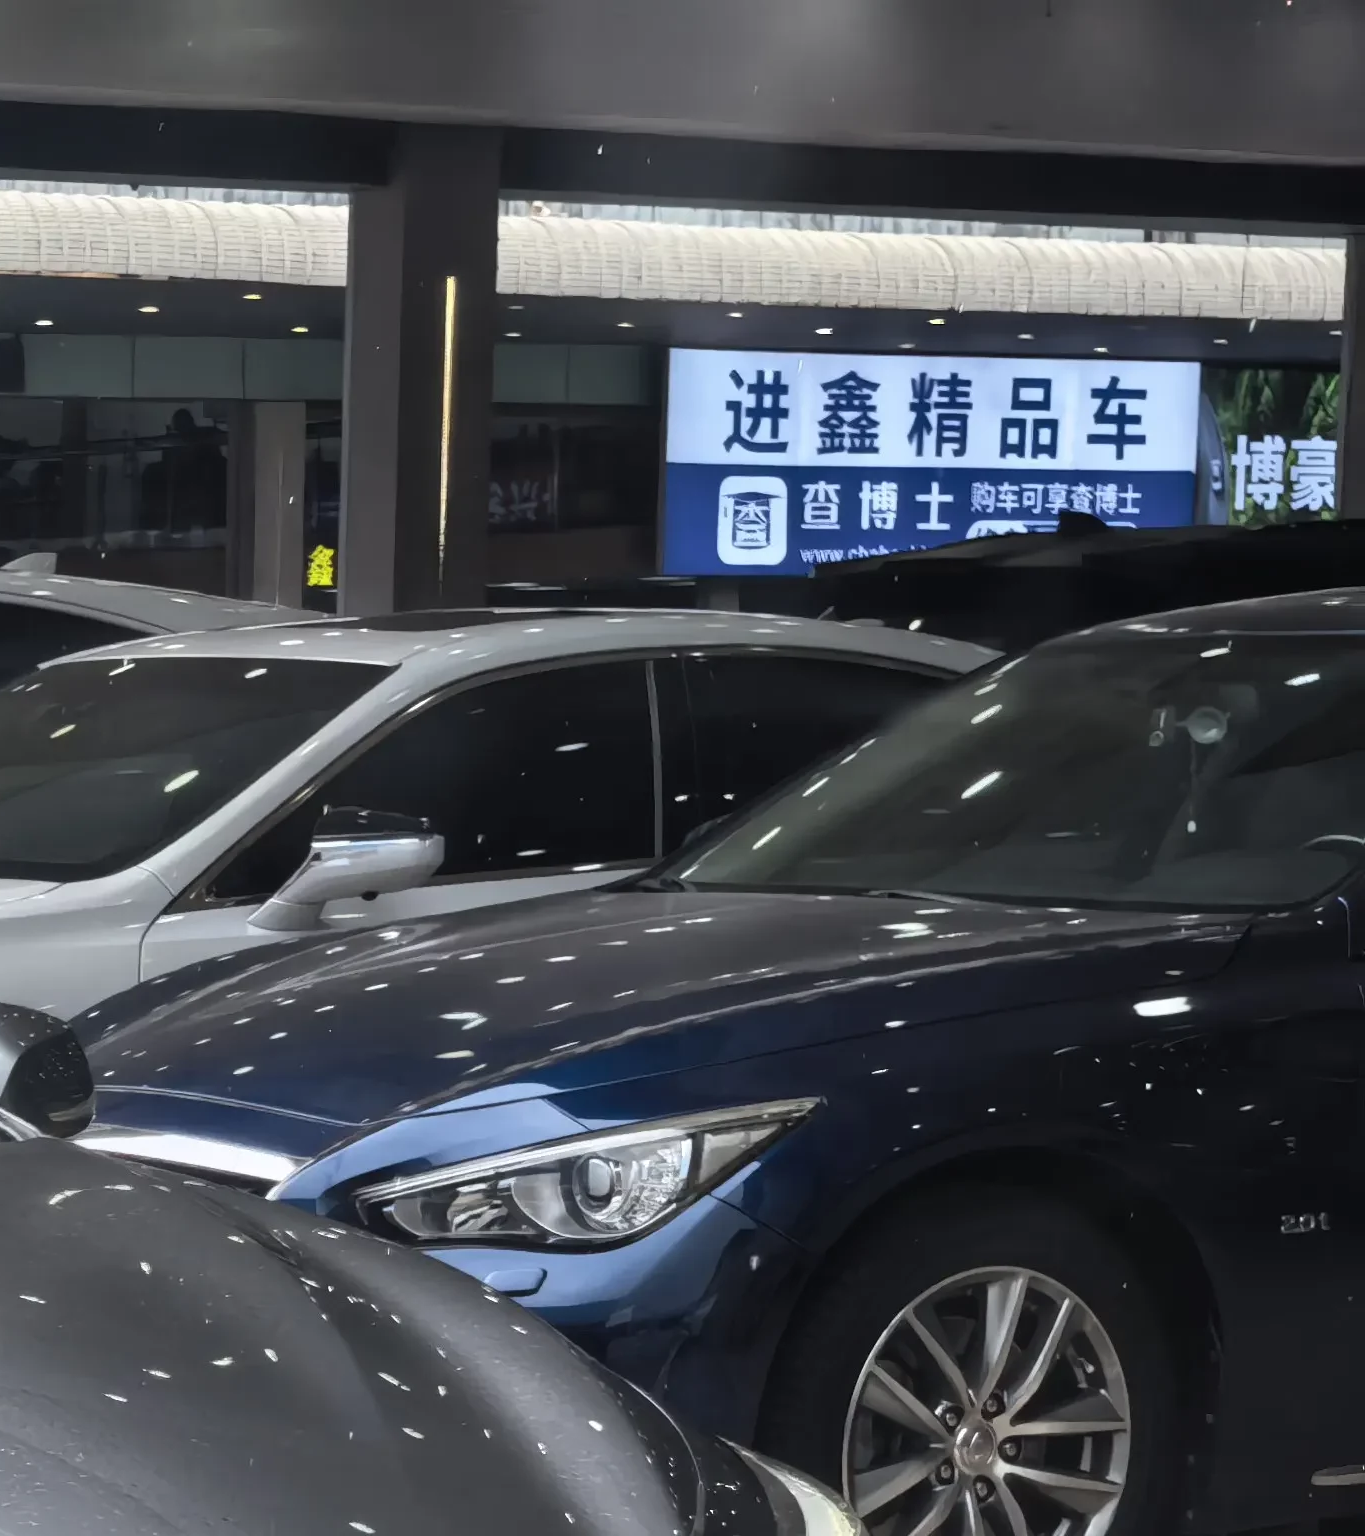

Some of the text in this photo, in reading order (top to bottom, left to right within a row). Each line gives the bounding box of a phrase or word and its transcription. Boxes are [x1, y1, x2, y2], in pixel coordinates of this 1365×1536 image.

[723, 369, 1148, 461] 进鑫精品车
[800, 481, 954, 531] 查博士
[970, 482, 1142, 514] 购车可享查博士
